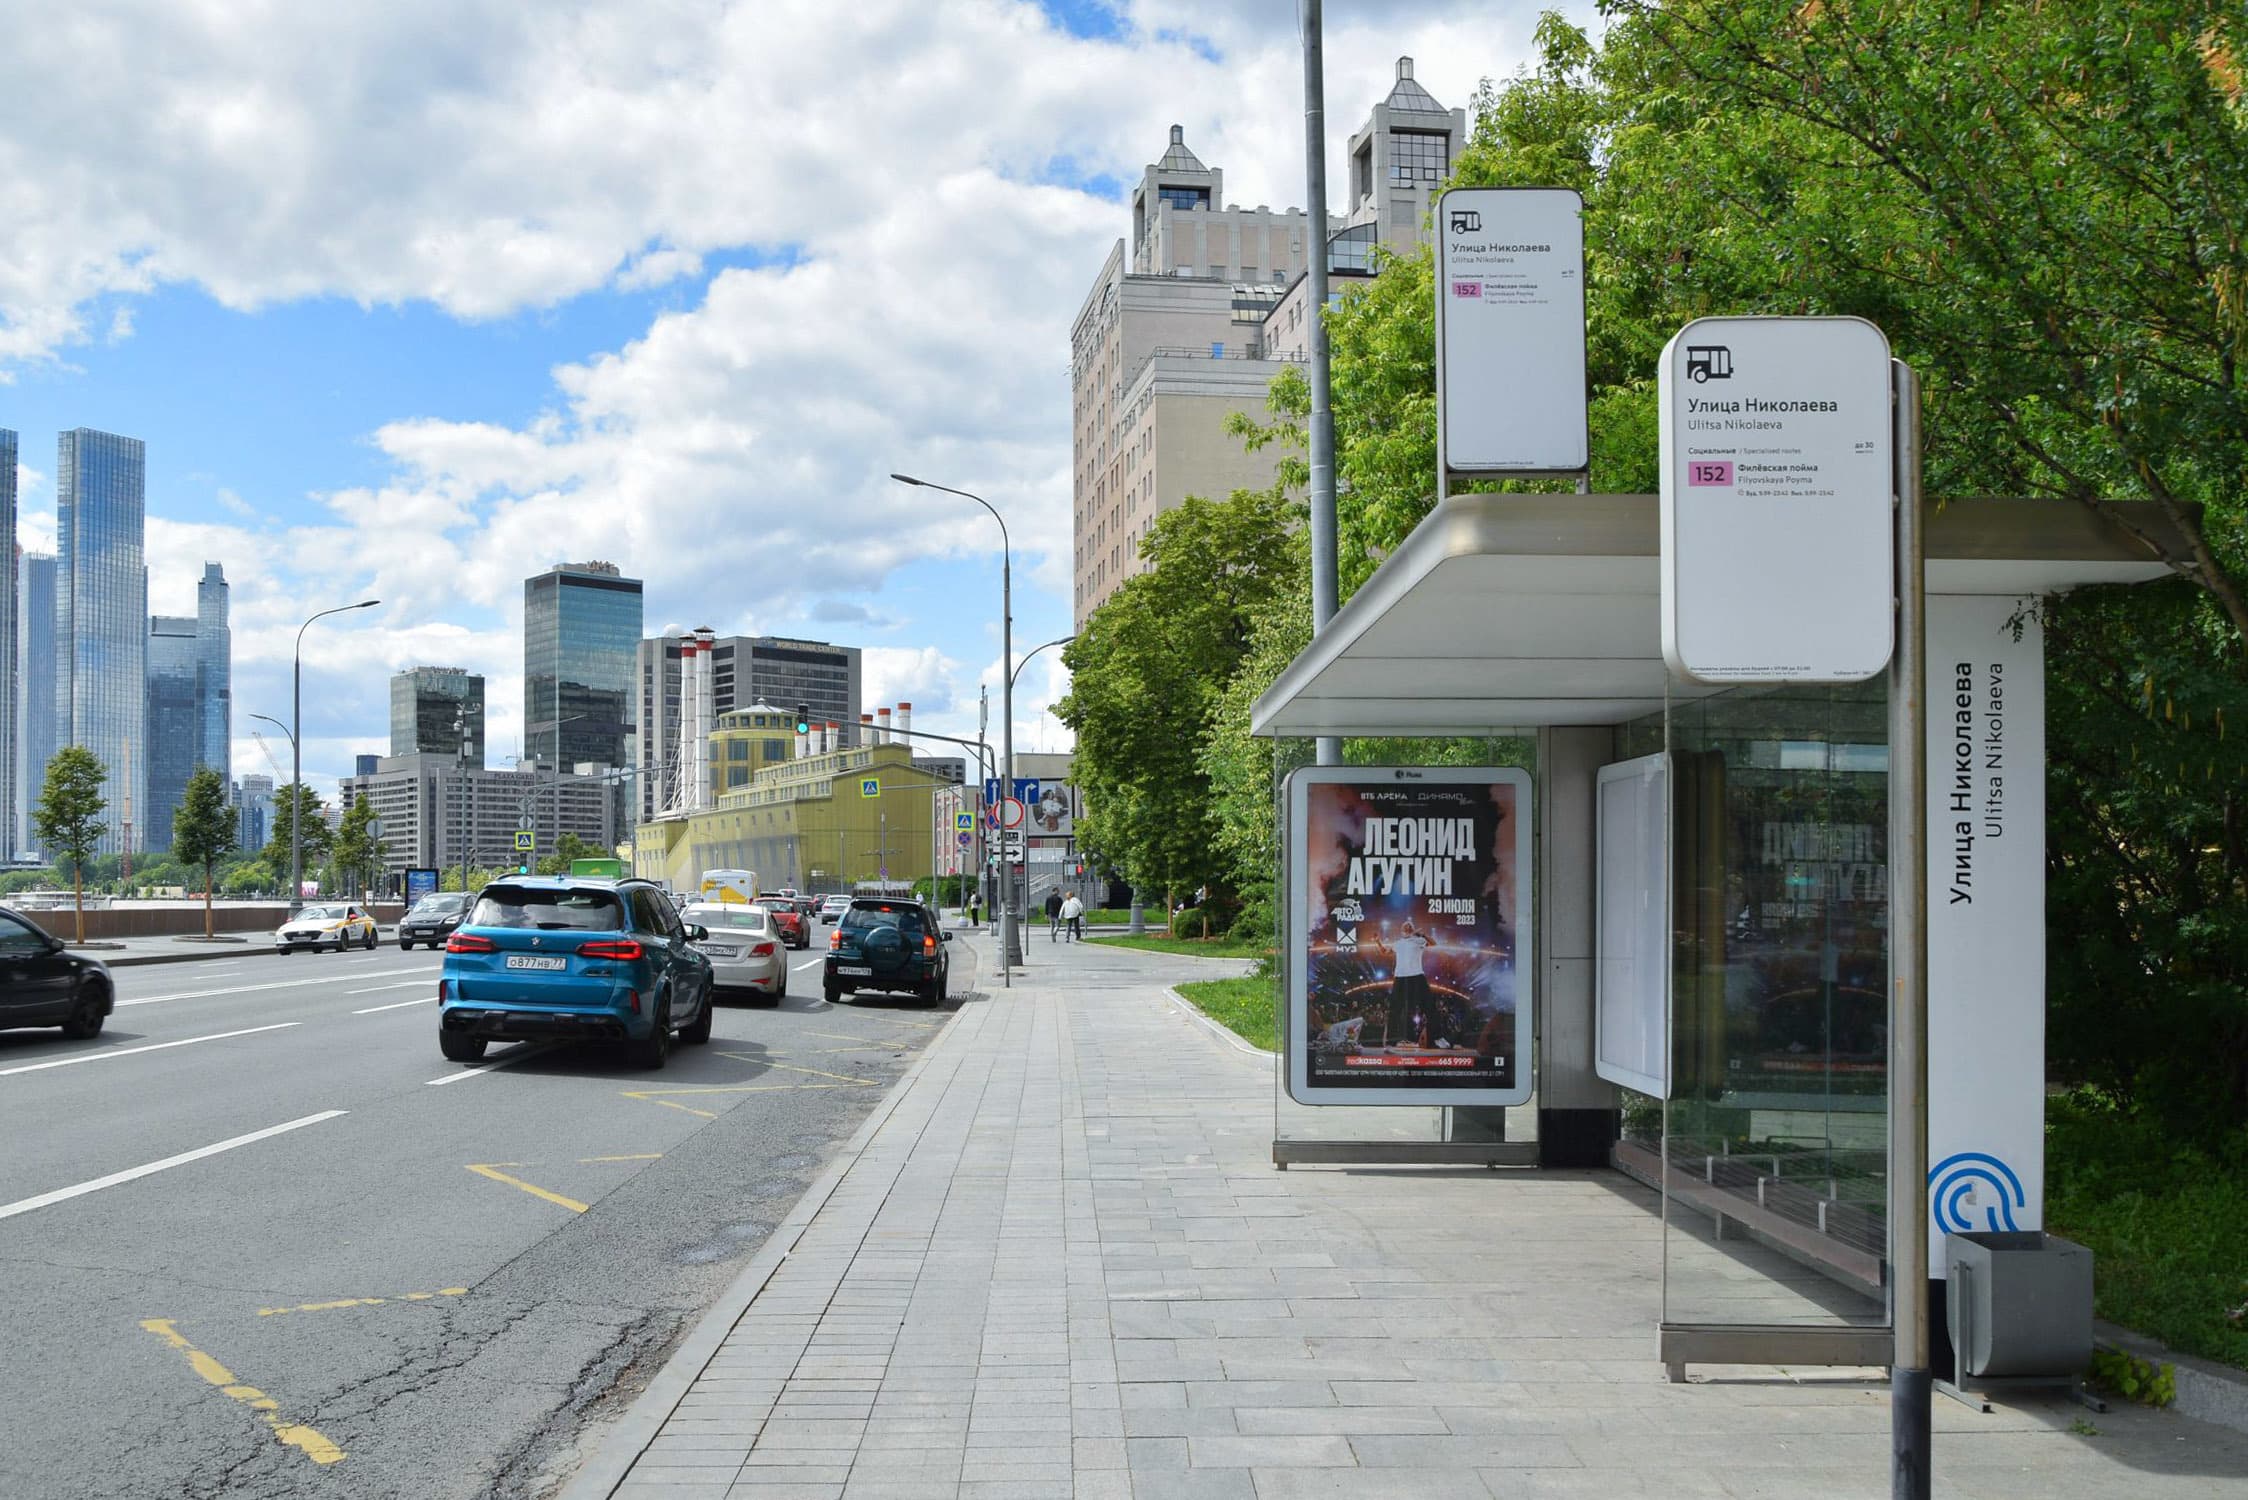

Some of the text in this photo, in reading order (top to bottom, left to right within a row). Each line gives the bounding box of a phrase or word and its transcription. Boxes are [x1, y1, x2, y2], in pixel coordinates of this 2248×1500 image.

[1452, 243, 1551, 253] Улица Николаева
[1456, 285, 1477, 295] 152
[1688, 398, 1838, 414] Улица Николаева
[1688, 420, 1783, 430] Ulitsa Nikolaeva
[1688, 447, 1737, 455] Социальные
[1738, 463, 1818, 473] Филёвская пойма
[1695, 466, 1725, 482] 152
[1738, 475, 1812, 485] Filyovskaya Poyma
[1984, 663, 2003, 838] Ulitsa Nikolaeva
[1950, 662, 1975, 904] Улица Николаева
[1360, 792, 1408, 800] ВТБ АРЕНА
[1363, 817, 1476, 861] ЛЕОНИД
[1347, 857, 1452, 895] АГУТИН
[1428, 898, 1475, 913] 29 ИЮЛЯ
[1456, 915, 1475, 925] 2023
[552, 958, 563, 967] 77
[1438, 1058, 1452, 1066] 665
[1453, 1058, 1473, 1066] 9999
